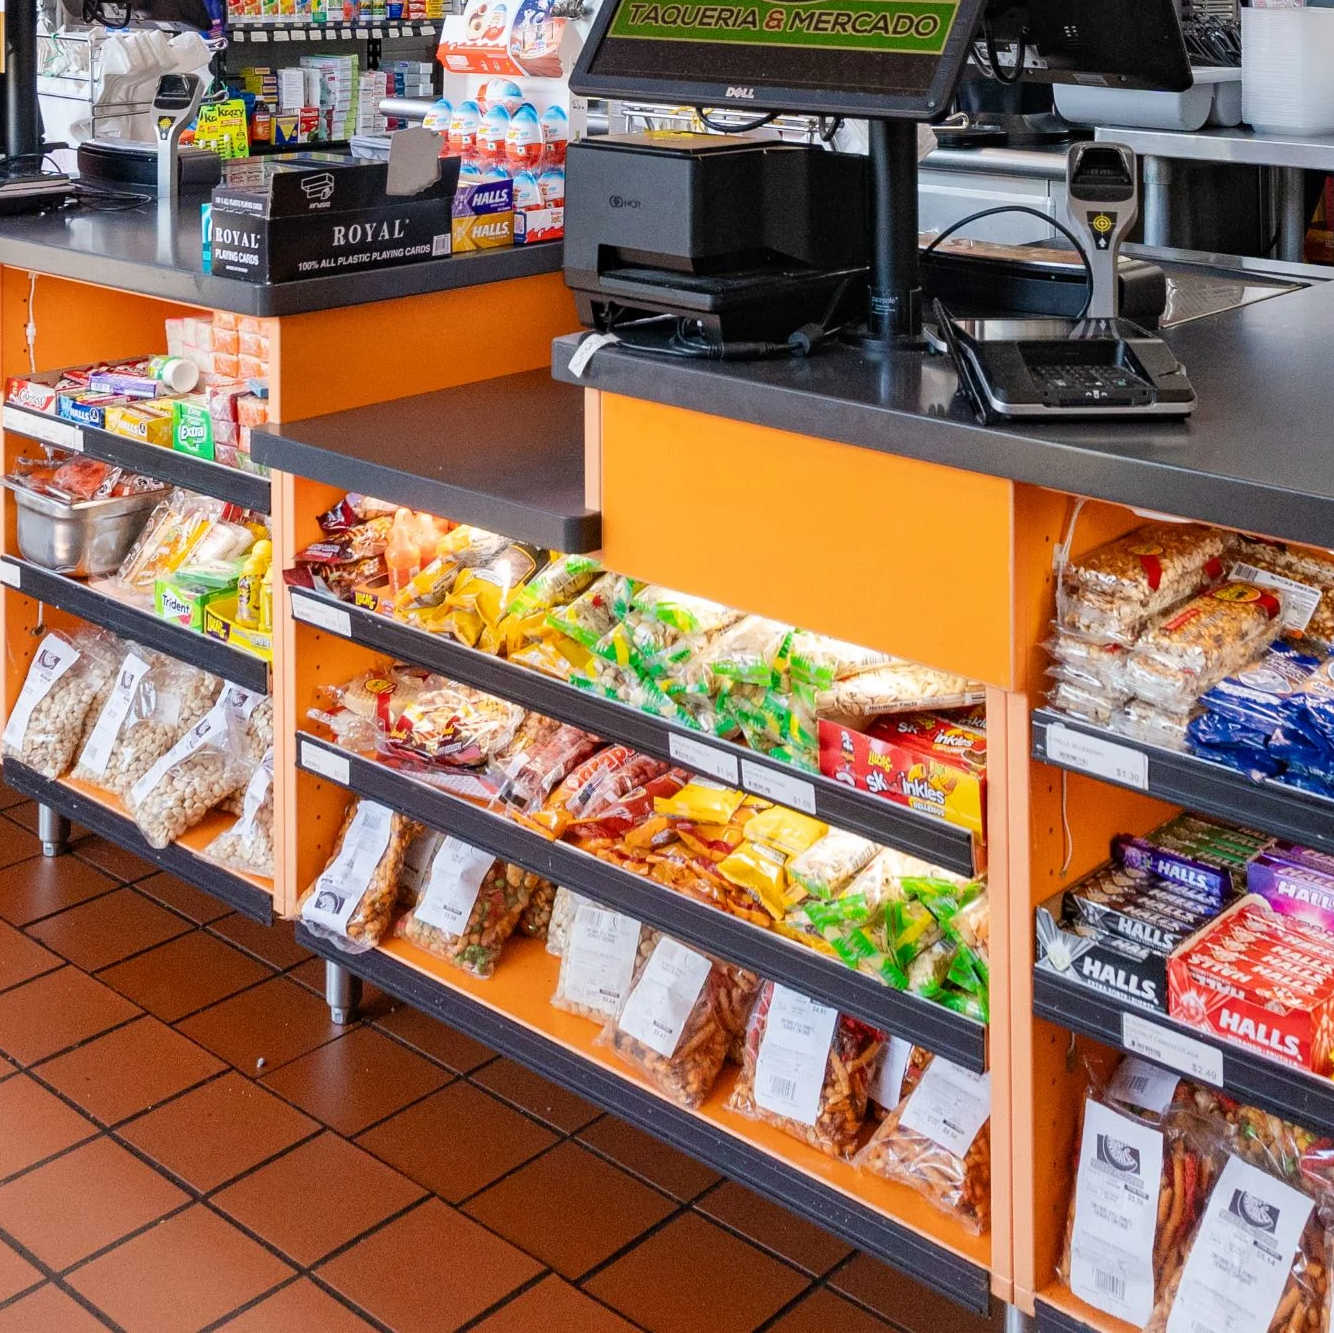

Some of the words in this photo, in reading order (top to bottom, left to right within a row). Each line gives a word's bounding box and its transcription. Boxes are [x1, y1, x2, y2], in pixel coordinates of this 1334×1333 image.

[629, 2, 760, 29] TAQUERIA
[763, 9, 786, 32] &
[787, 9, 941, 39] MERCADO
[725, 86, 755, 100] DELL
[471, 188, 509, 207] HALLS
[215, 227, 258, 249] ROYAL
[332, 218, 405, 247] ROYAL
[471, 221, 510, 239] HALLS
[215, 248, 238, 263] PLAYING
[238, 251, 259, 266] CARDS
[298, 259, 319, 272] 100%
[320, 256, 337, 268] ALL
[337, 253, 371, 267] PLASTIC
[371, 248, 405, 263] PLAYING
[404, 244, 431, 257] CARDS
[69, 406, 90, 421] HALLS
[180, 423, 204, 439] Extra
[162, 594, 191, 614] Trident
[1157, 860, 1208, 890] HALLS
[1116, 916, 1182, 950] HALLS
[1082, 957, 1157, 1004] HALLS
[1219, 1008, 1302, 1060] HALLS
[1191, 1062, 1218, 1080] $2.49
